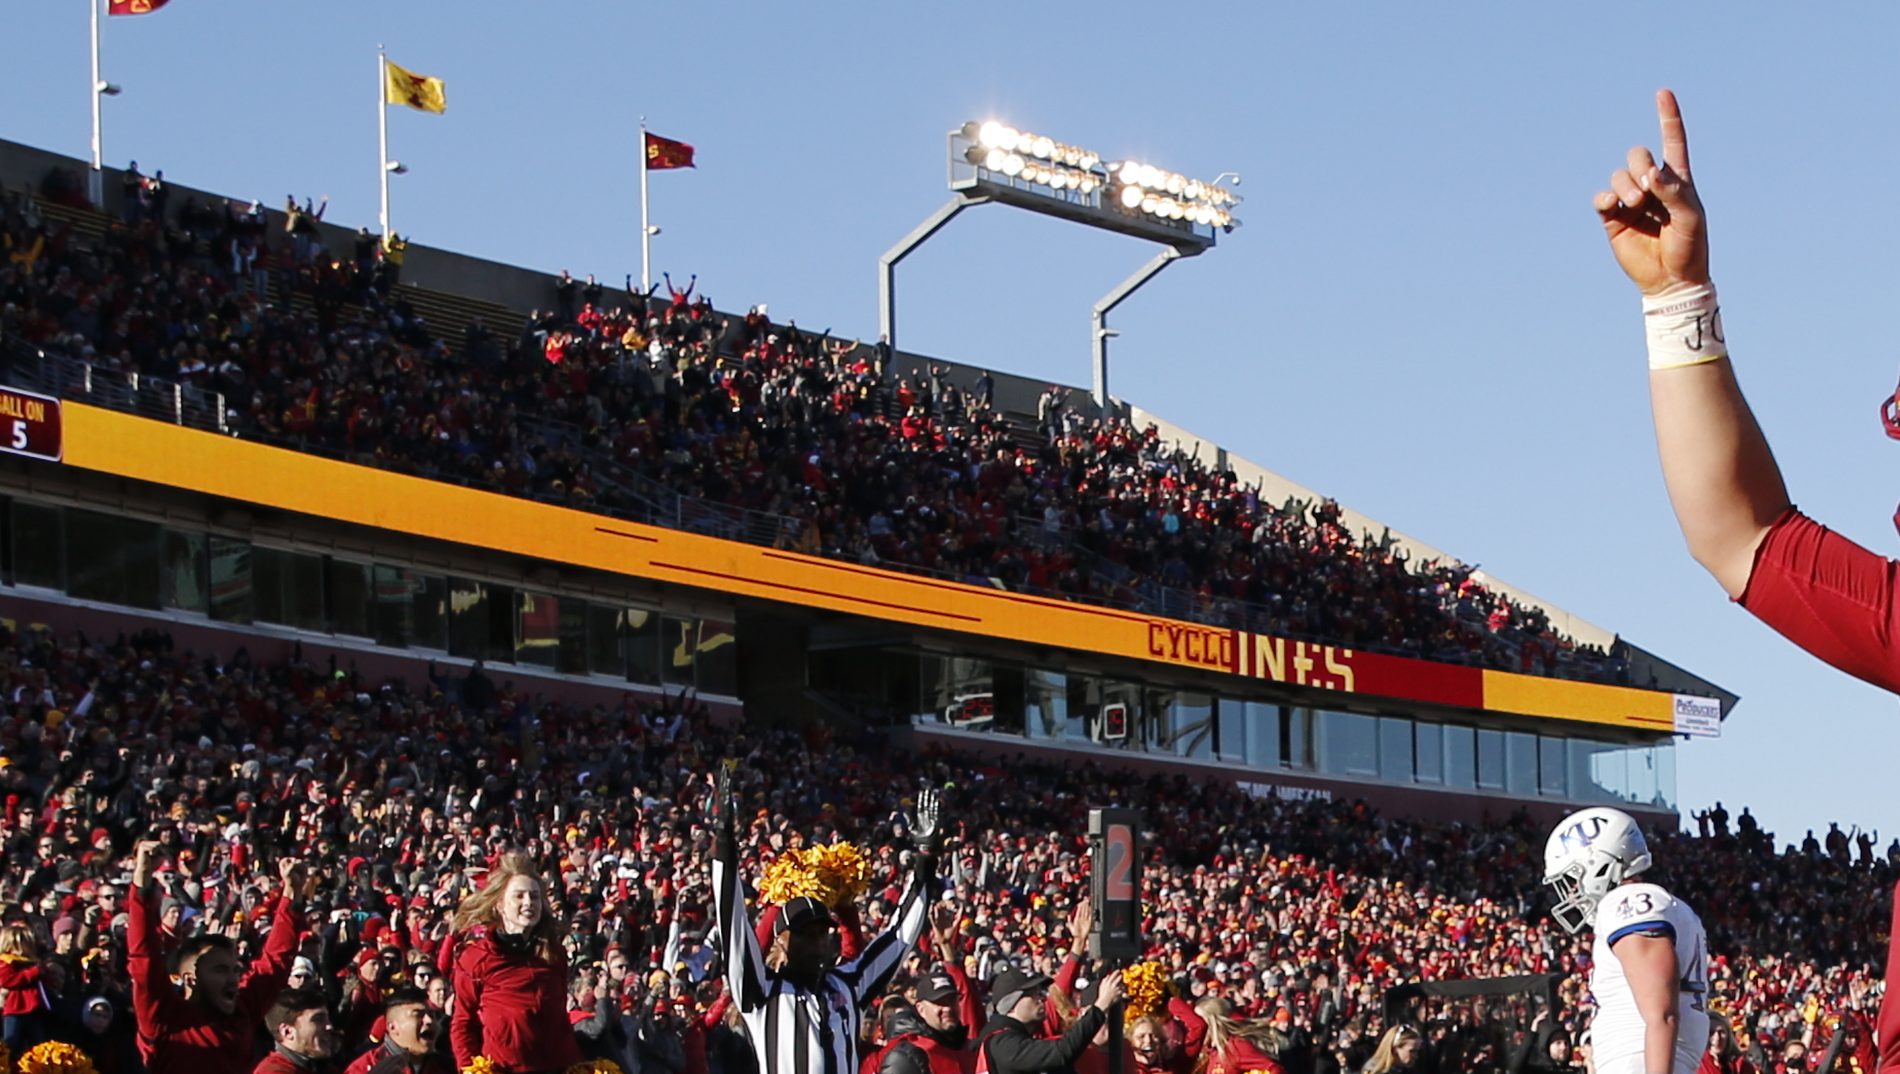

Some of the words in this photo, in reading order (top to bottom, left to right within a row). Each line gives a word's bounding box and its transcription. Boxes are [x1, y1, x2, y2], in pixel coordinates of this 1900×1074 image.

[0, 394, 24, 418] ALL
[26, 401, 44, 422] ON
[12, 419, 28, 449] 5
[1557, 816, 1609, 849] KU
[1106, 824, 1134, 901] 2
[1615, 892, 1655, 920] 43
